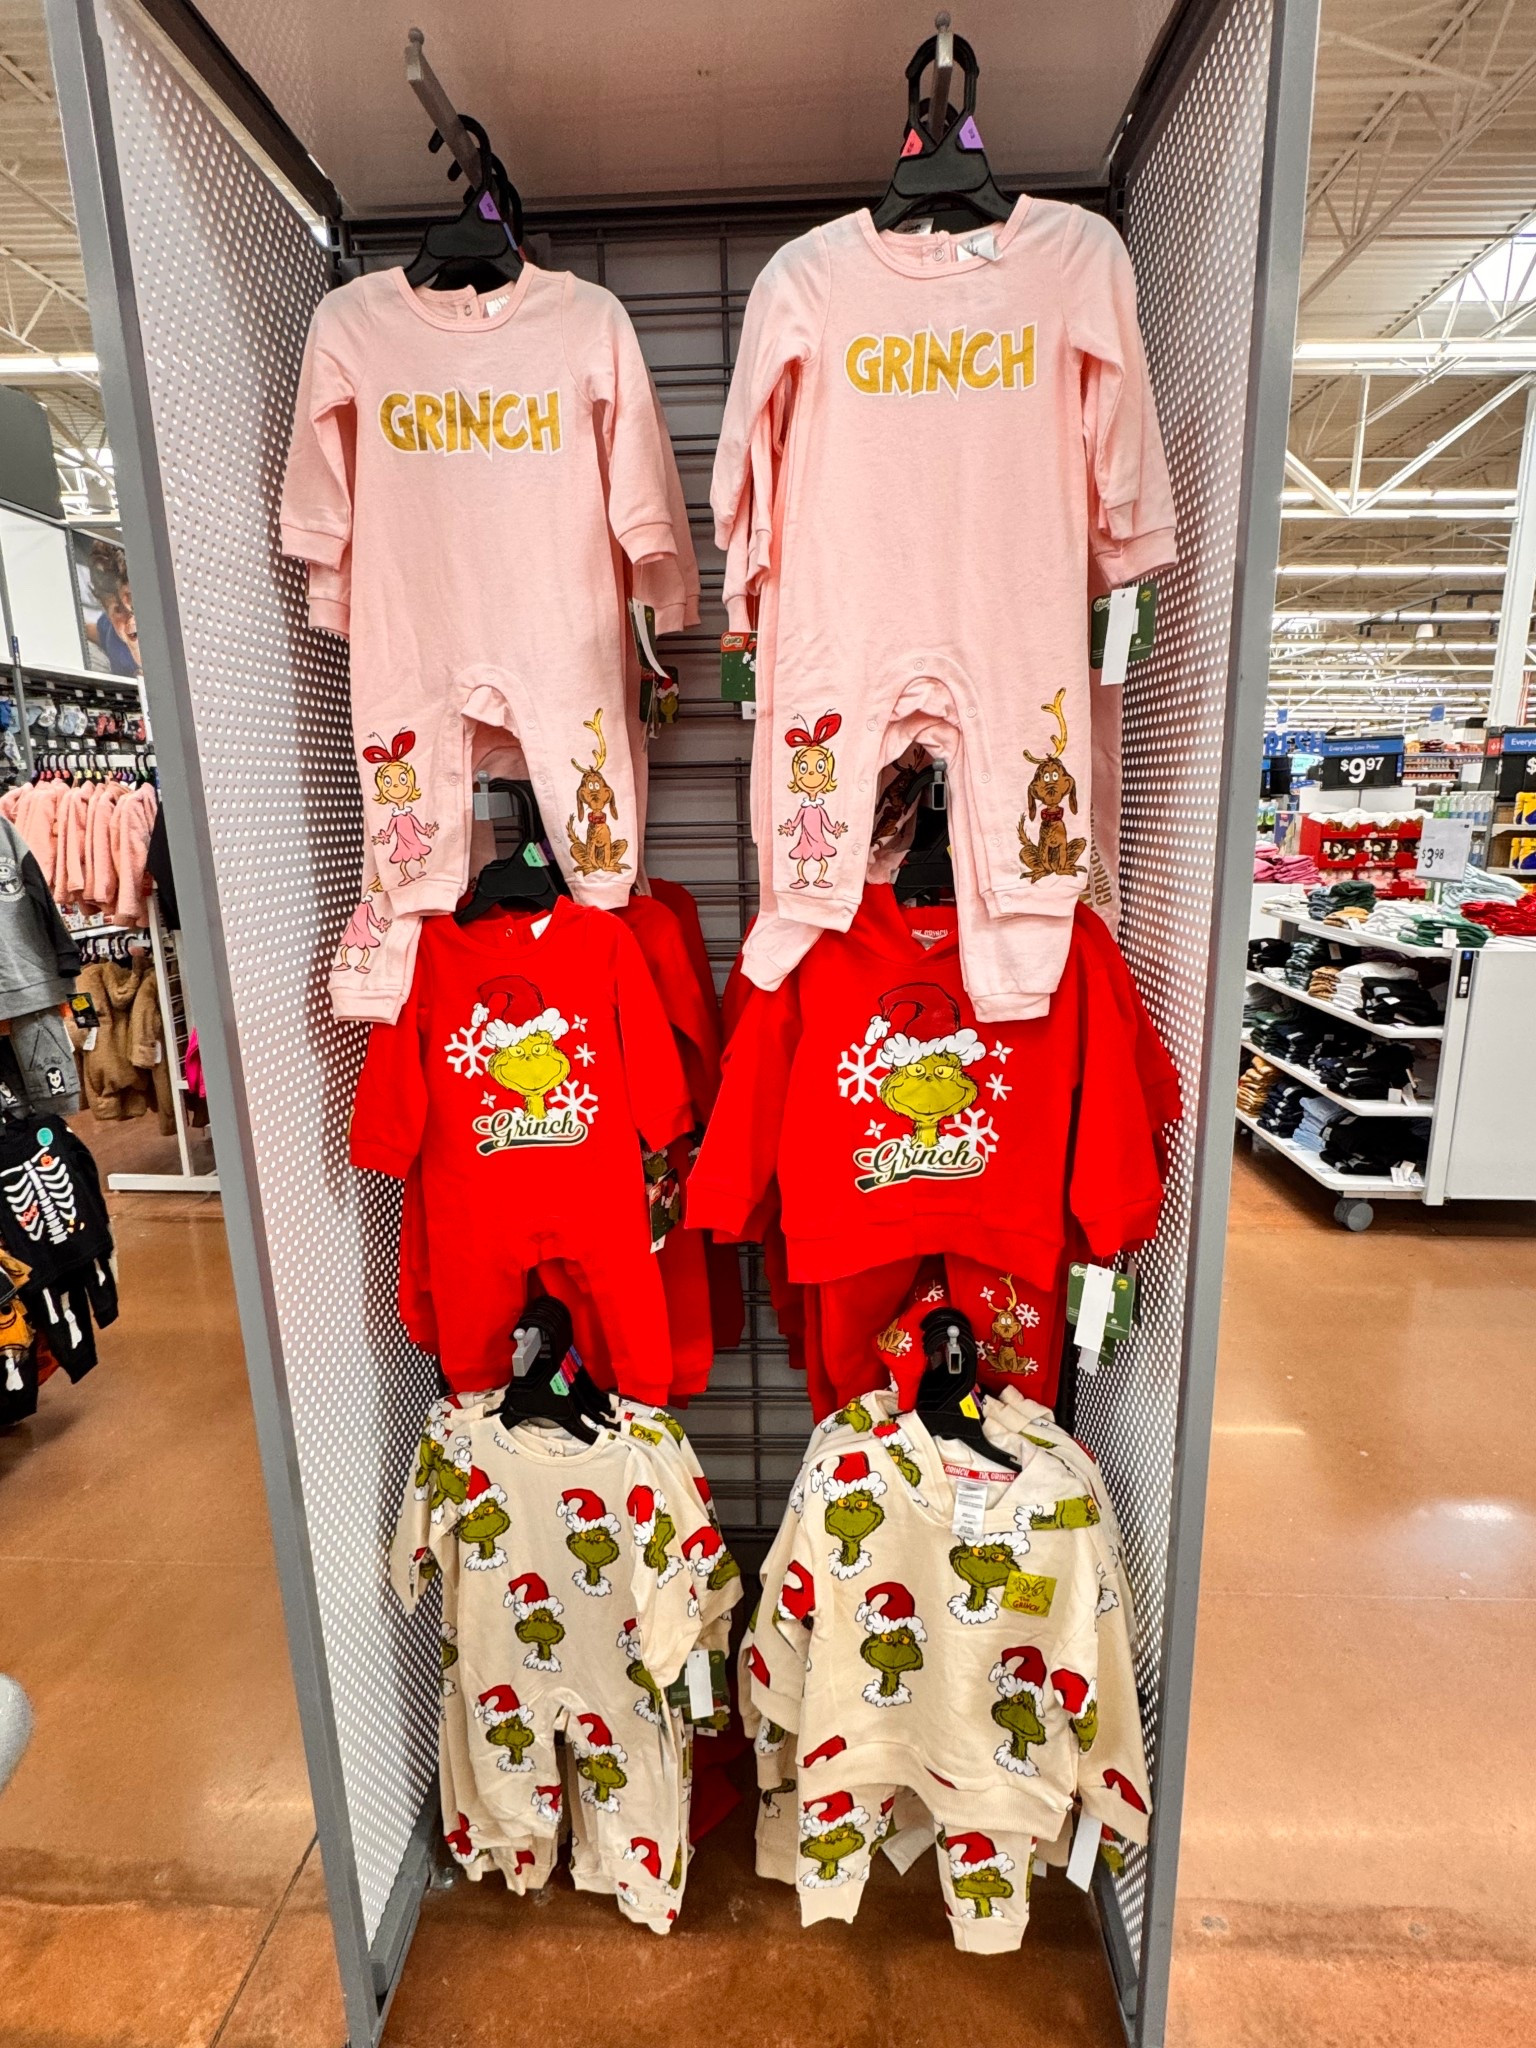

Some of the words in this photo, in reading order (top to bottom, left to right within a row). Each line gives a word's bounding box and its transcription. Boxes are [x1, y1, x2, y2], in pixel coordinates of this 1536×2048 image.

[844, 322, 1037, 400] GRINCH
[378, 387, 561, 461] GRINCH
[482, 1110, 580, 1149] Grinch
[864, 1140, 979, 1186] Grinch
[945, 1465, 970, 1478] GRINCH
[990, 1472, 1015, 1481] GRINCH
